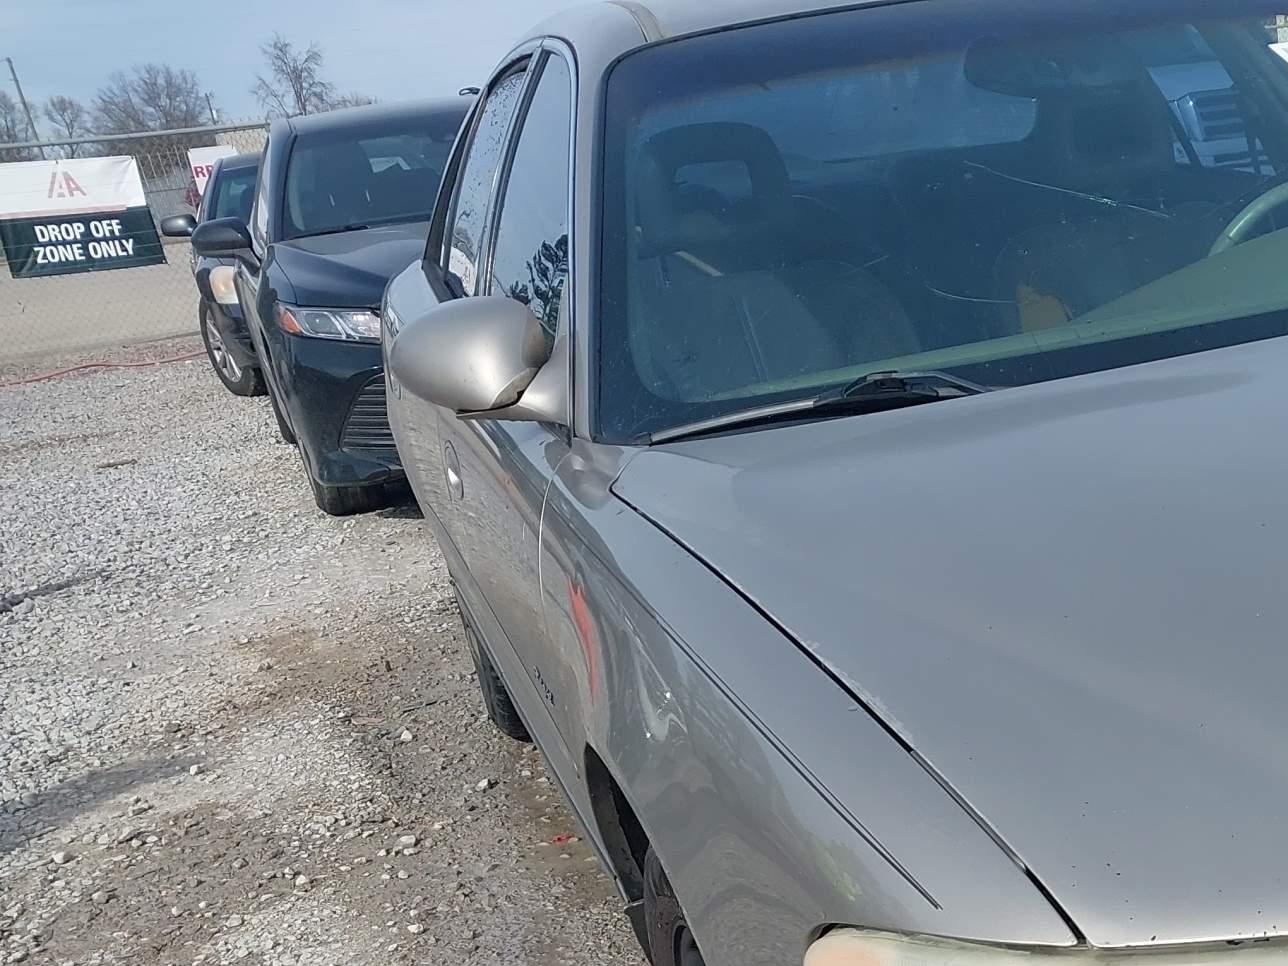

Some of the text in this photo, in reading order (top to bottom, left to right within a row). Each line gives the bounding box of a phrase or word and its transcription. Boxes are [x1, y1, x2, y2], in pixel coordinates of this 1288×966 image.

[34, 219, 122, 243] DROP OFF
[33, 238, 134, 264] ZONE ONLY
